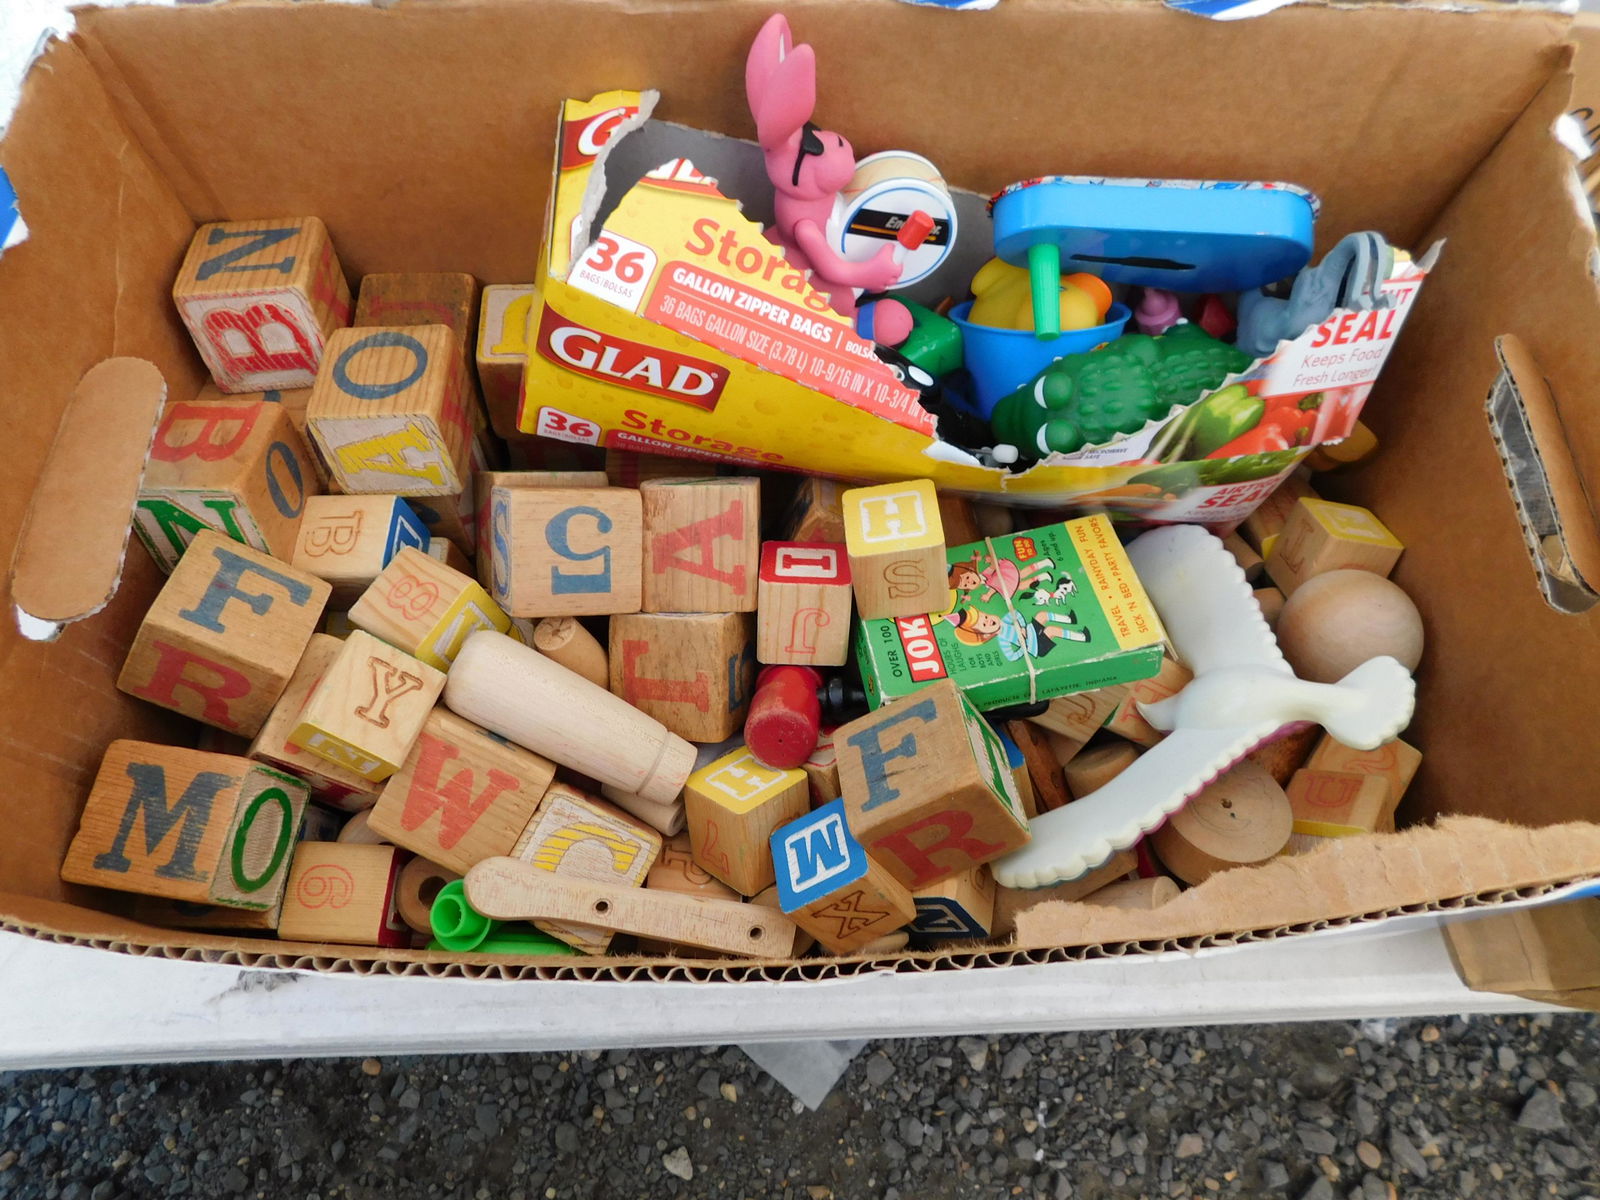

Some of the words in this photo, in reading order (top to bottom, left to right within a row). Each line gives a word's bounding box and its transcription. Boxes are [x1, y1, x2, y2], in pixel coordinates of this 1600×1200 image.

[195, 226, 302, 281] N
[586, 236, 646, 284] 36
[673, 267, 736, 303] GALLON
[735, 291, 789, 327] ZIPPER
[790, 313, 833, 343] BAGS
[1311, 309, 1396, 348] SEAL
[202, 302, 326, 377] B
[660, 294, 676, 314] 36
[675, 300, 704, 327] BAGS
[705, 312, 748, 345] GALLON
[746, 330, 771, 355] SIZE
[769, 340, 798, 366] (3.78
[795, 351, 808, 374] L)
[809, 357, 852, 388] 10-9/16
[850, 370, 862, 393] IN
[862, 378, 875, 398] X
[874, 383, 908, 413] 10-3/4
[1301, 352, 1346, 369] Keeps
[1349, 348, 1384, 362] Food
[332, 331, 428, 400] O
[1292, 372, 1328, 387] Fresh
[151, 402, 263, 463] B
[544, 411, 594, 438] 36
[617, 432, 672, 449] GALLON
[621, 409, 785, 462] Storage
[335, 422, 447, 486] A
[304, 508, 363, 558] B
[651, 499, 747, 596] A
[1075, 525, 1088, 543] FUN
[1088, 517, 1108, 549] FAVORS
[1084, 548, 1110, 590] RAINYDAY
[1104, 551, 1121, 577] PARTY
[178, 547, 312, 634] F
[387, 574, 439, 621] 8
[1119, 582, 1133, 599] BED
[880, 625, 893, 643] 100
[899, 617, 940, 674] JOK
[1111, 605, 1131, 638] TRAVEL
[1132, 613, 1149, 634] SICK
[132, 640, 252, 729] R
[888, 650, 903, 677] OVER
[354, 655, 424, 729] Y
[846, 697, 938, 813] F
[401, 731, 521, 851] W
[93, 762, 238, 883] M
[872, 810, 1007, 888] R
